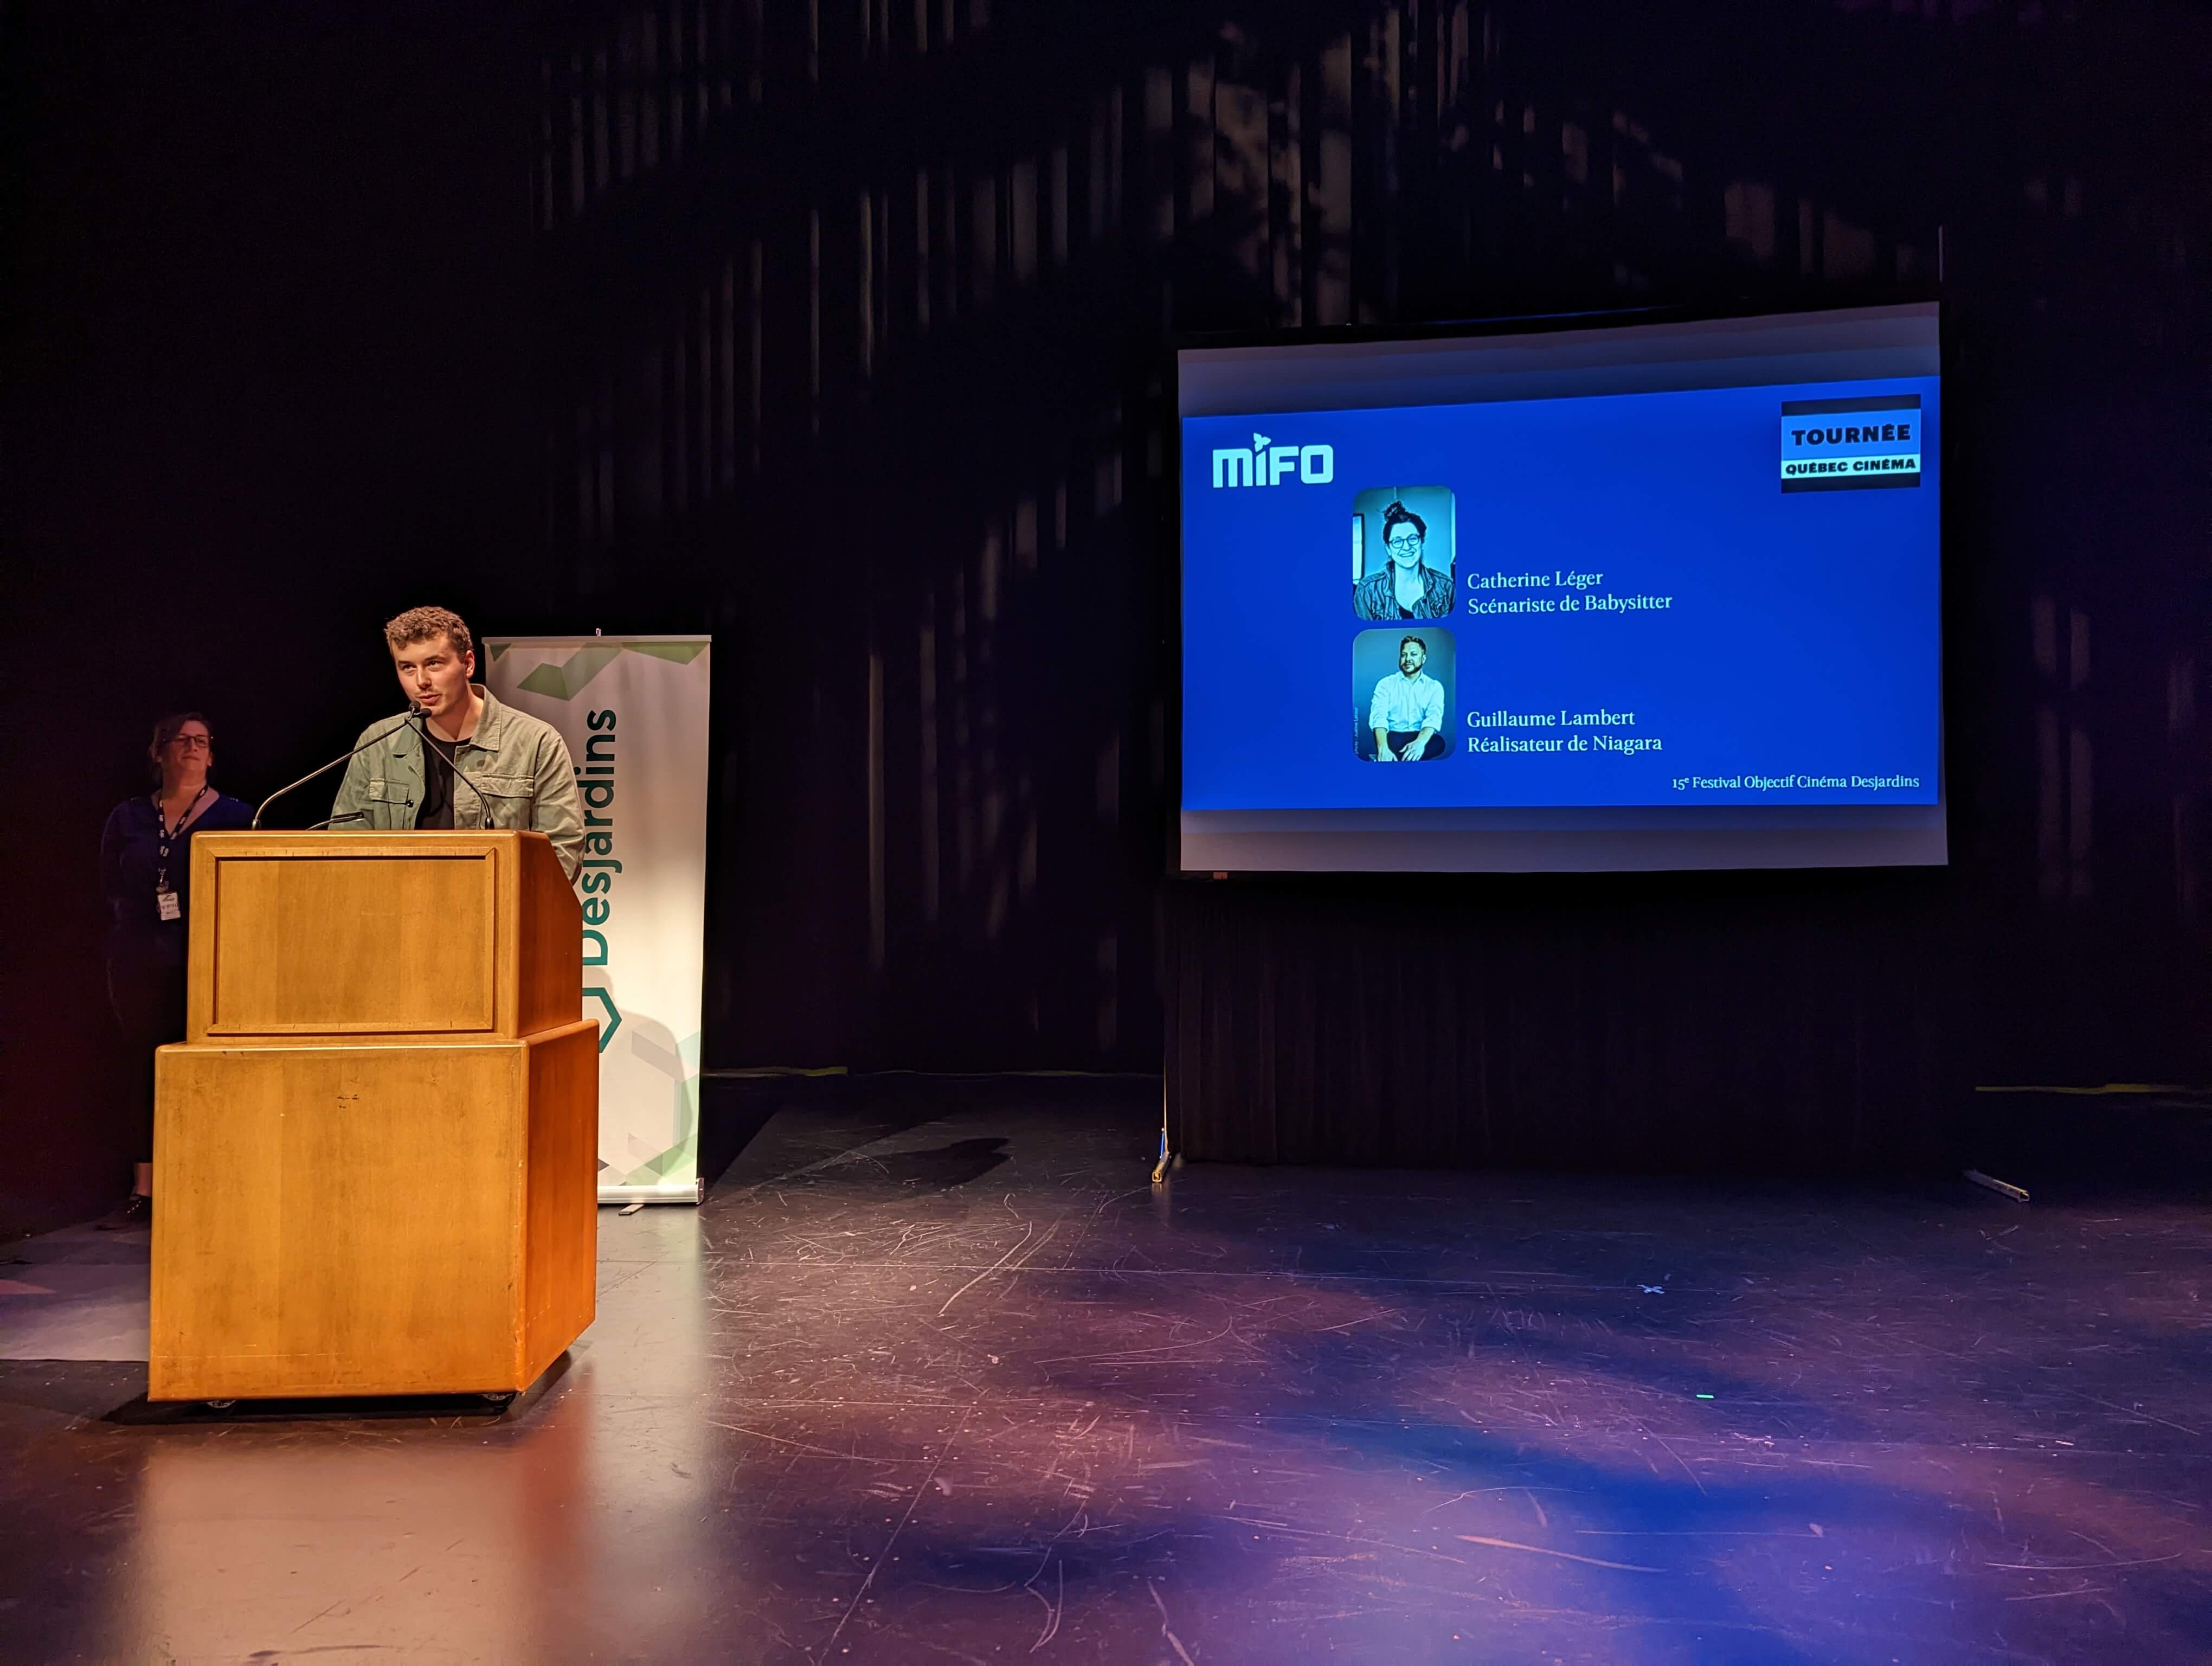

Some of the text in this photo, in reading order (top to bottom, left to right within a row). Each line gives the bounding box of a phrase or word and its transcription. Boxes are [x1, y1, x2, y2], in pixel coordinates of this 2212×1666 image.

[1791, 423, 1911, 446] TOURNÉE
[1785, 458, 1917, 476] QUÉBEC CINÉMA
[1467, 571, 1604, 590] Catherine Léger
[1468, 593, 1673, 614] Scénariste de Babysitter
[1467, 708, 1636, 728] Guillaume Lambert
[1468, 734, 1663, 755] Réalisateur de Niagara
[1692, 775, 1741, 789] Festival
[1744, 774, 1795, 792] Objectif
[1796, 775, 1848, 788] Cinéma
[1850, 774, 1920, 791] Desjardins
